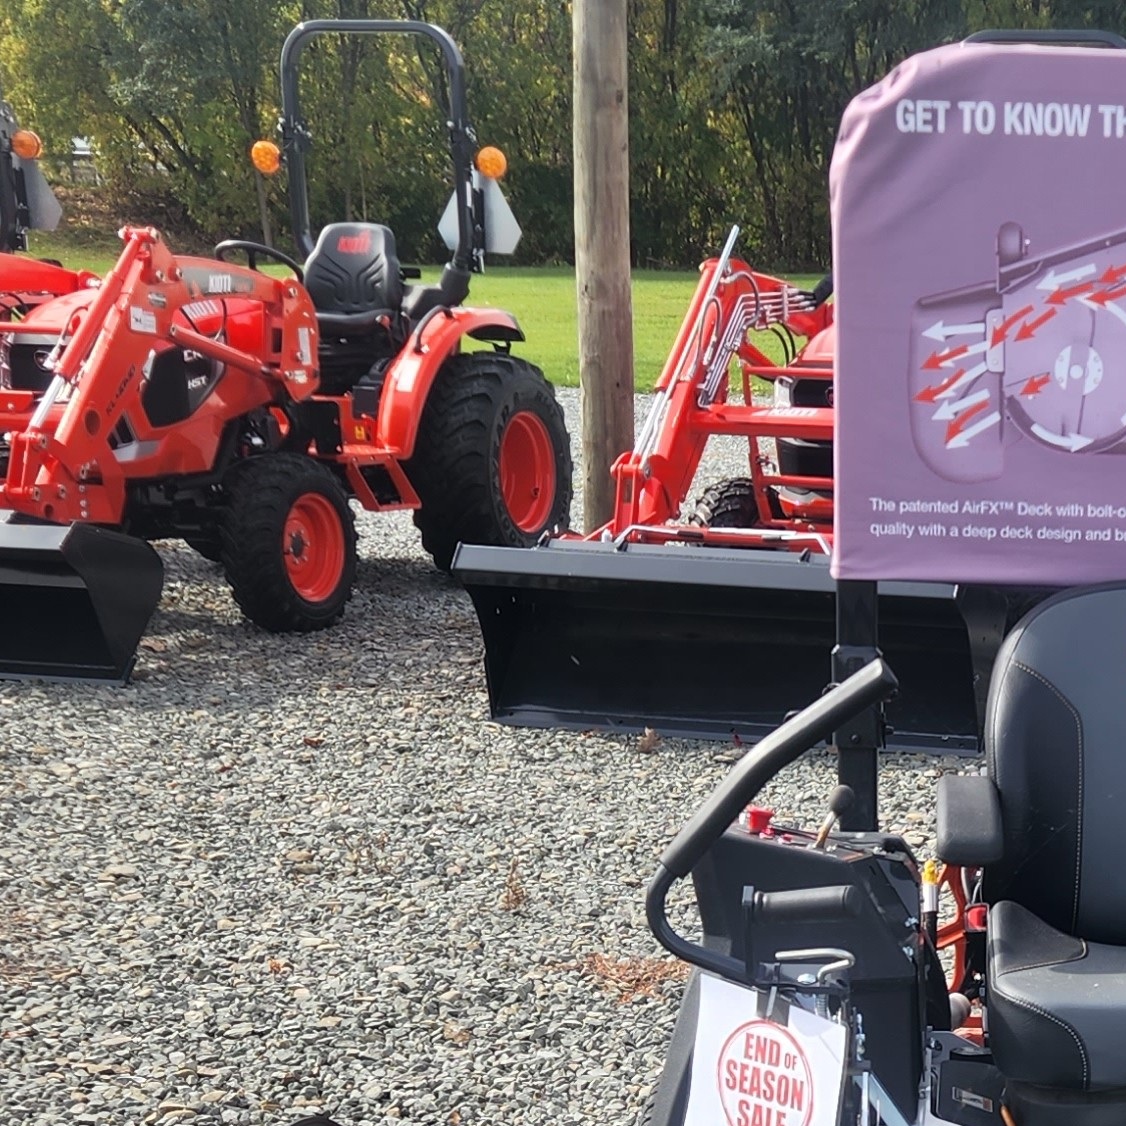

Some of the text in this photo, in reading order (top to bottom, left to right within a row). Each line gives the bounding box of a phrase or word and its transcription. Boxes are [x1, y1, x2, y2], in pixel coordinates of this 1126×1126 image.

[896, 99, 950, 134] GET
[957, 101, 996, 135] TO
[1003, 101, 1092, 137] KNOW
[208, 274, 232, 293] KIOTI
[181, 299, 219, 320] KIOTI
[187, 376, 207, 390] HST
[869, 498, 896, 512] The
[900, 500, 958, 514] patented
[1017, 502, 1053, 516] Deck
[1056, 504, 1084, 517] with
[870, 522, 915, 538] quality
[918, 524, 947, 537] with
[950, 527, 959, 538] a
[963, 525, 997, 541] deep
[1000, 526, 1033, 540] deck
[1037, 527, 1082, 543] design
[1085, 529, 1112, 542] and
[744, 1032, 797, 1071] END OF
[725, 1059, 804, 1112] SEASON
